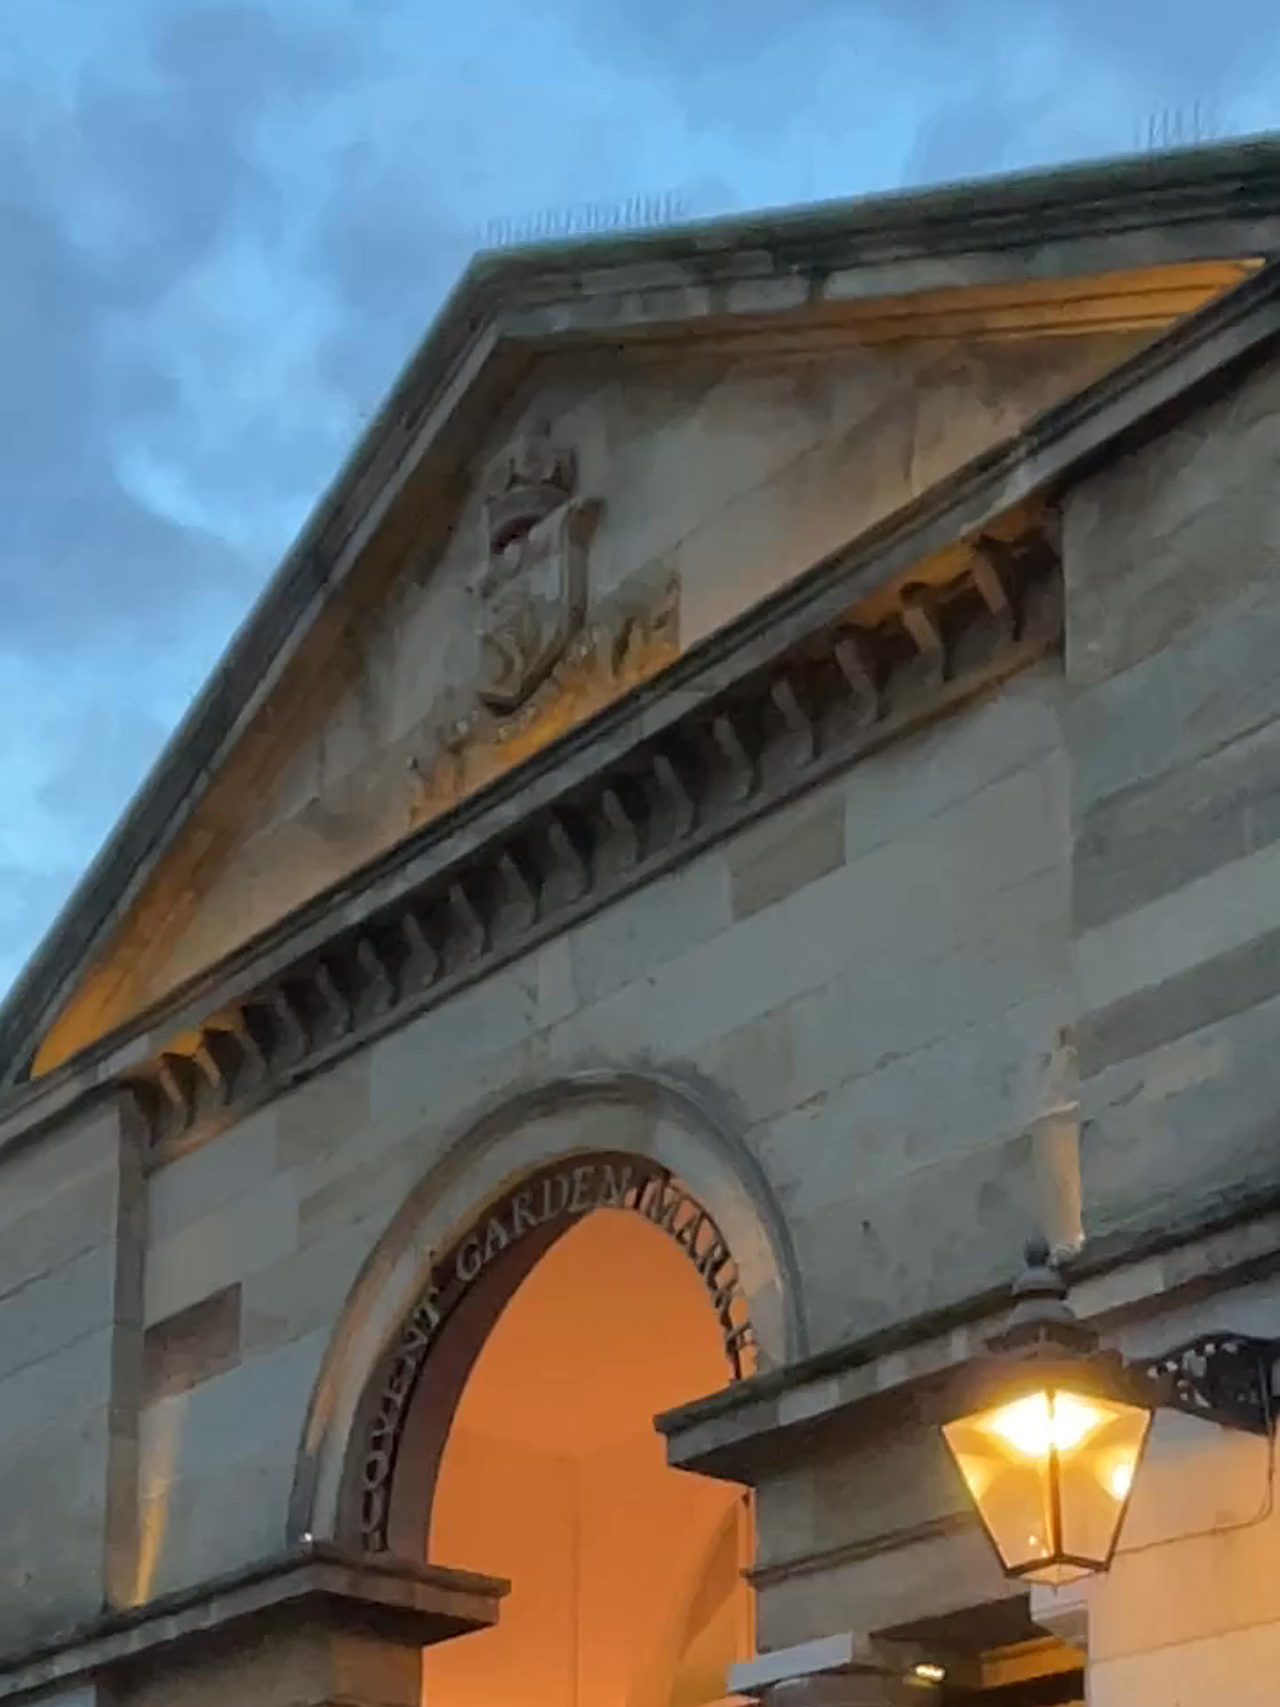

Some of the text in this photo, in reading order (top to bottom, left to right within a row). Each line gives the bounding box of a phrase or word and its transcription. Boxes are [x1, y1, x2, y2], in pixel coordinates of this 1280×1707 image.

[360, 1165, 762, 1535] COVENT GARDEN MARKE
